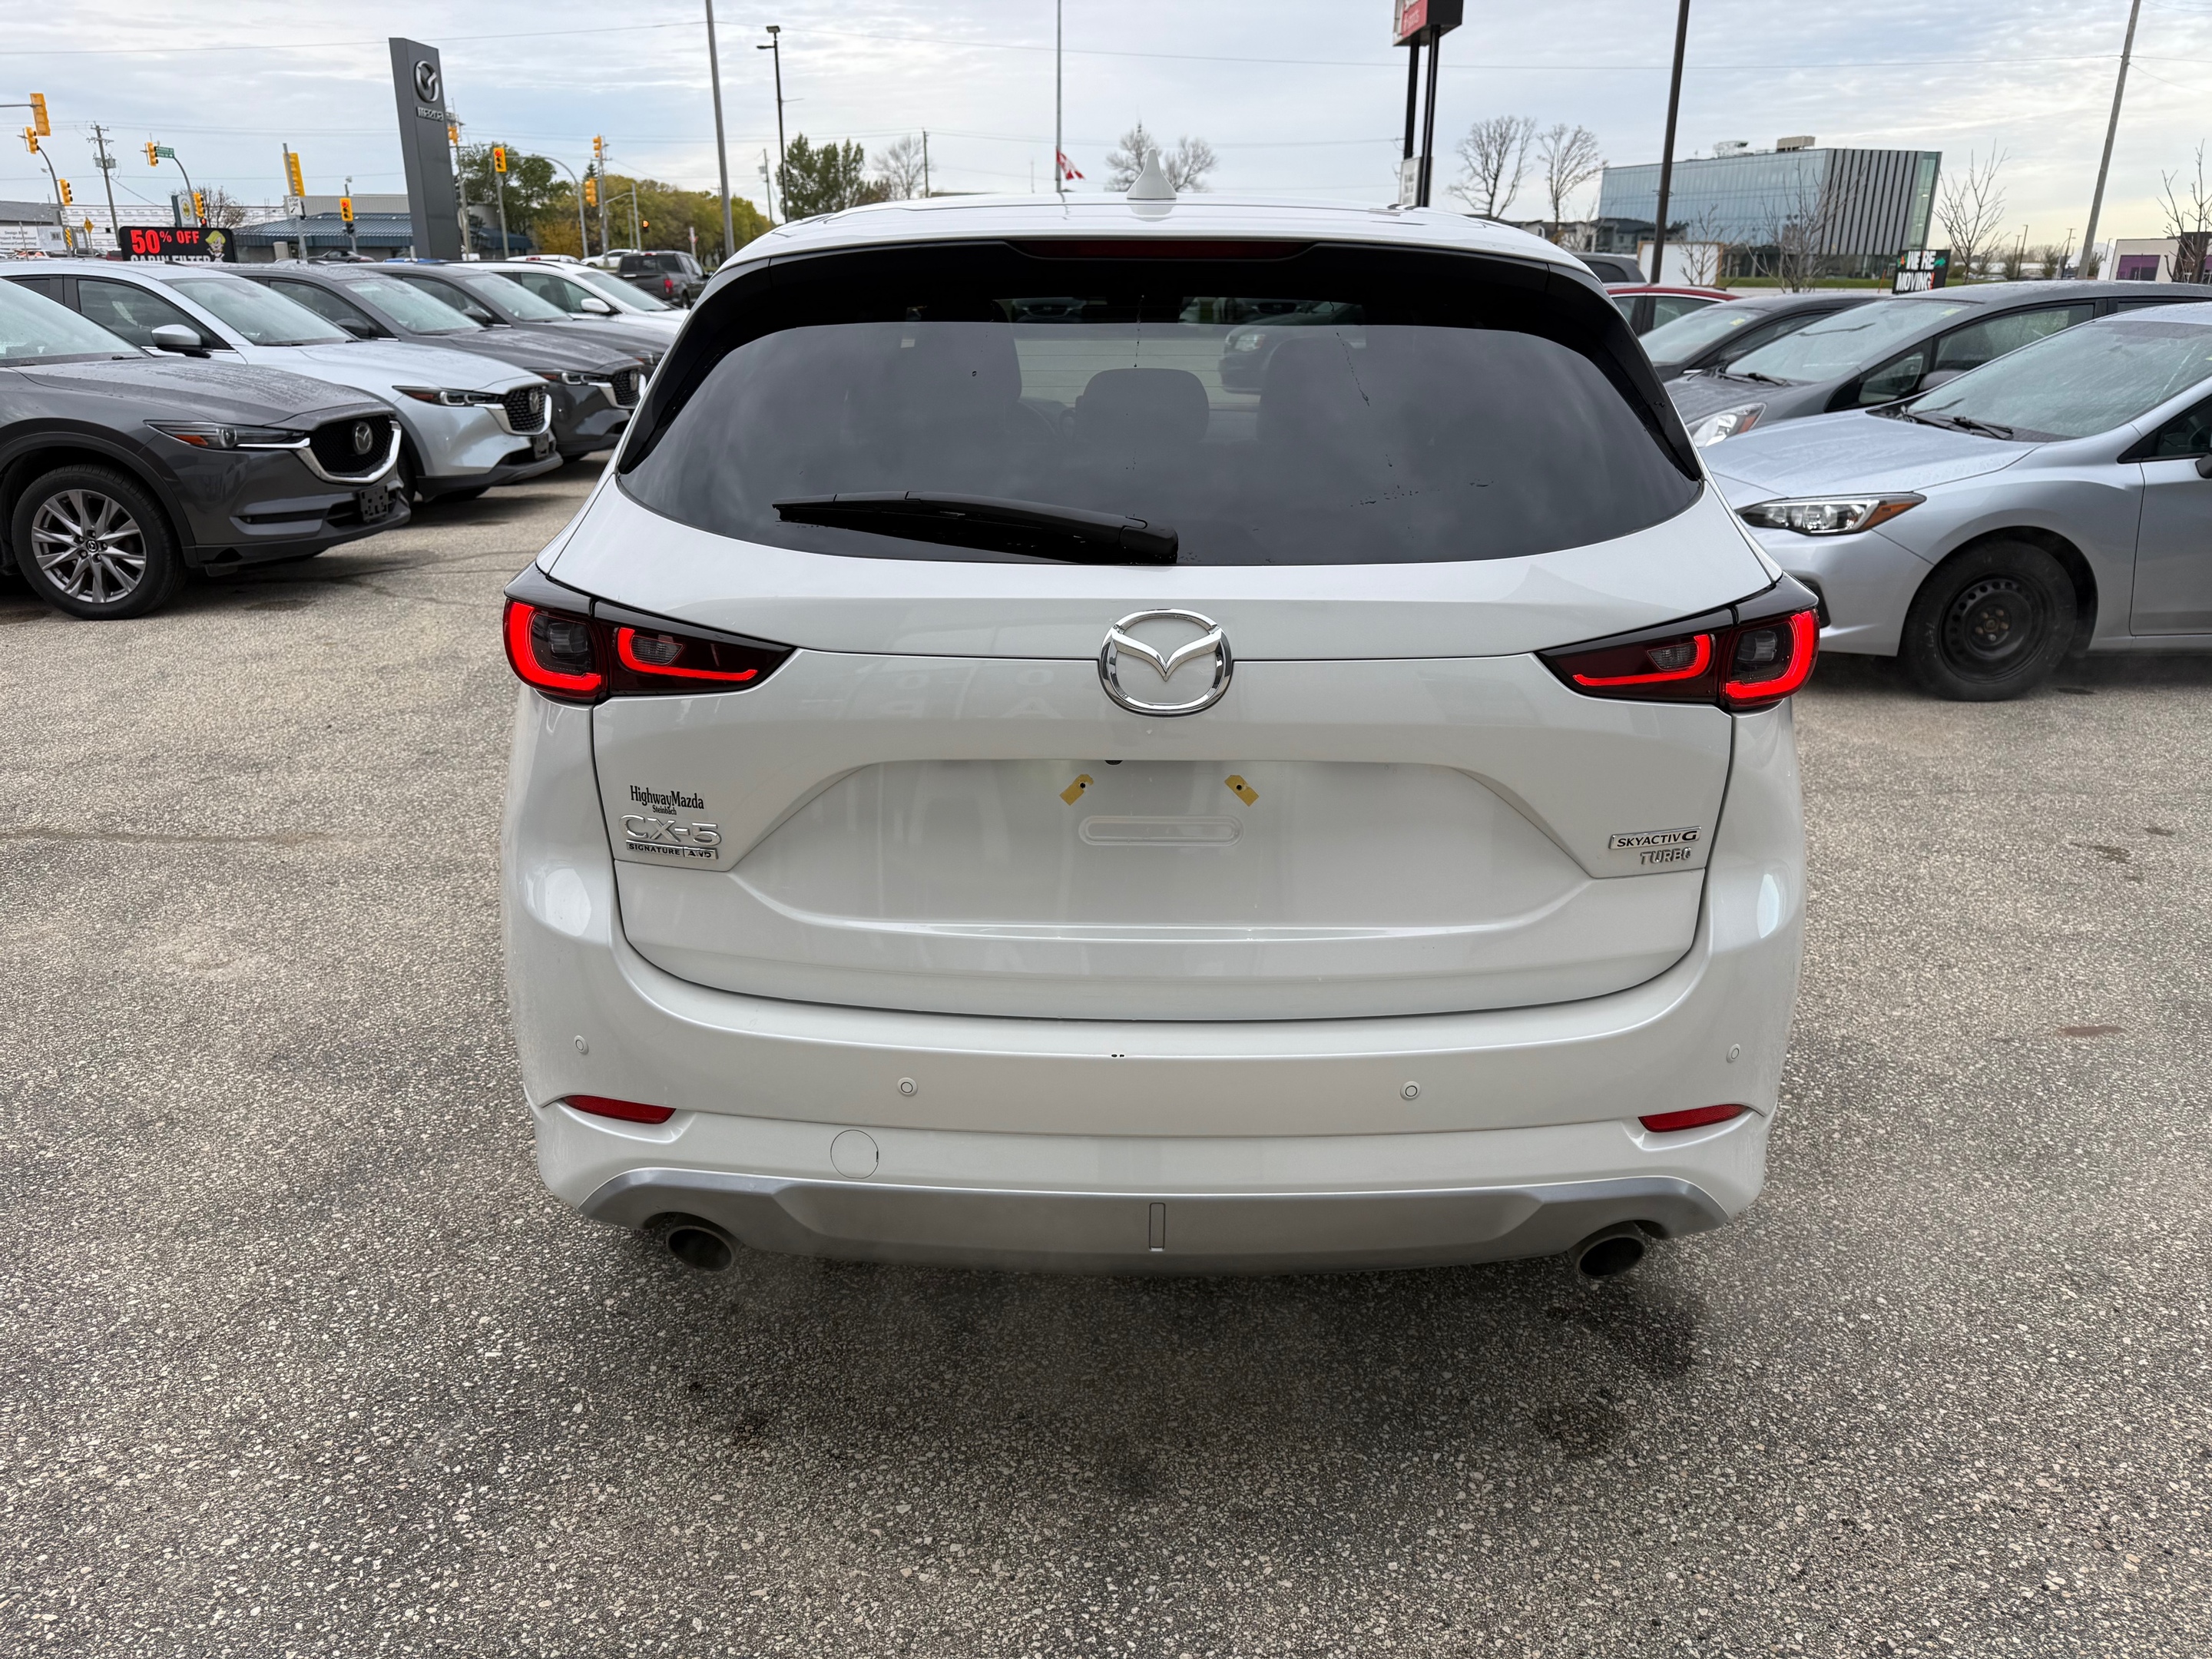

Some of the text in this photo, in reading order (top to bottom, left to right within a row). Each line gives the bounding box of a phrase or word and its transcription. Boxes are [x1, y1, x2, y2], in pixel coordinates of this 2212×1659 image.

[130, 230, 200, 253] 50% OFF
[1896, 271, 1936, 291] MOVING!
[652, 805, 677, 816] Steinbach
[619, 814, 722, 846] CX-5
[628, 843, 680, 856] SIGNATURE
[1641, 847, 1692, 865] TURBO
